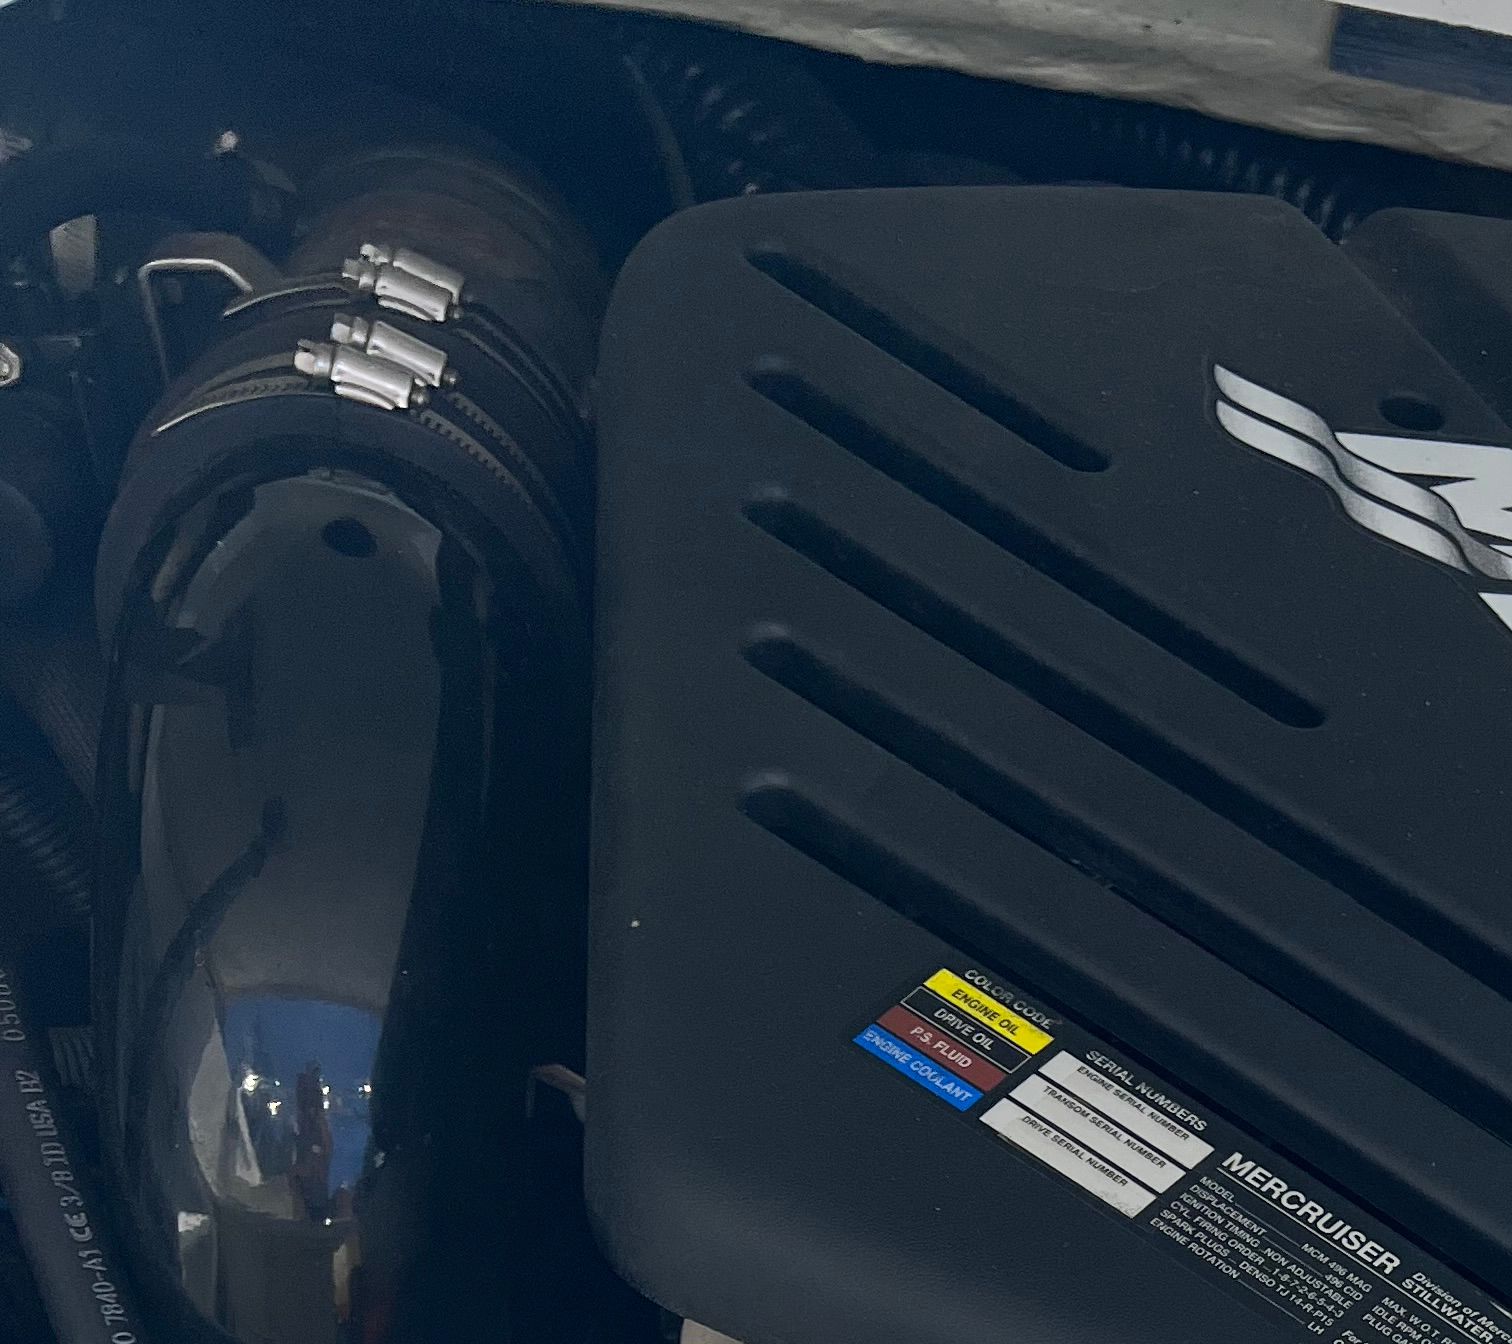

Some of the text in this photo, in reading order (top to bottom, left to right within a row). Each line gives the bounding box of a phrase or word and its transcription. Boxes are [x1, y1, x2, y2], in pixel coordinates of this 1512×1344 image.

[934, 1008, 995, 1052] DRIVE OIL
[951, 988, 1021, 1037] ENGINE OIL
[965, 968, 1054, 1030] COLOR CODE
[862, 1030, 973, 1103] ENGINE COOLANT
[911, 1026, 972, 1069] P.S. FLUID
[1044, 1086, 1167, 1169] TRANSOM SERIAL NUMBER
[1077, 1065, 1189, 1142] ENGINE SERIAL NUMBER
[1085, 1050, 1208, 1132] SERIAL NUMBERS
[1021, 1115, 1129, 1188] DRIVE SERIAL NUMBER
[1160, 1210, 1275, 1288] SPARK PLUGS DENSO
[1189, 1184, 1364, 1301] DISPLACEMENT 496 CID
[1193, 1214, 1265, 1266] FIRING ORDER
[1200, 1177, 1372, 1293] MODEL MCM MAG
[1222, 1152, 1400, 1275] MERCRUISER
[1151, 1218, 1325, 1335] ENGINE ROTATION LH
[1180, 1193, 1354, 1310] IGNITION TIMING NON ADJUSTABLE
[1362, 1313, 1392, 1336] PLUG
[1372, 1305, 1396, 1323] IDLE
[1396, 1322, 1422, 1342] RPM
[1412, 1272, 1461, 1308] Division
[1462, 1305, 1481, 1318] of
[1341, 1330, 1362, 1344] For
